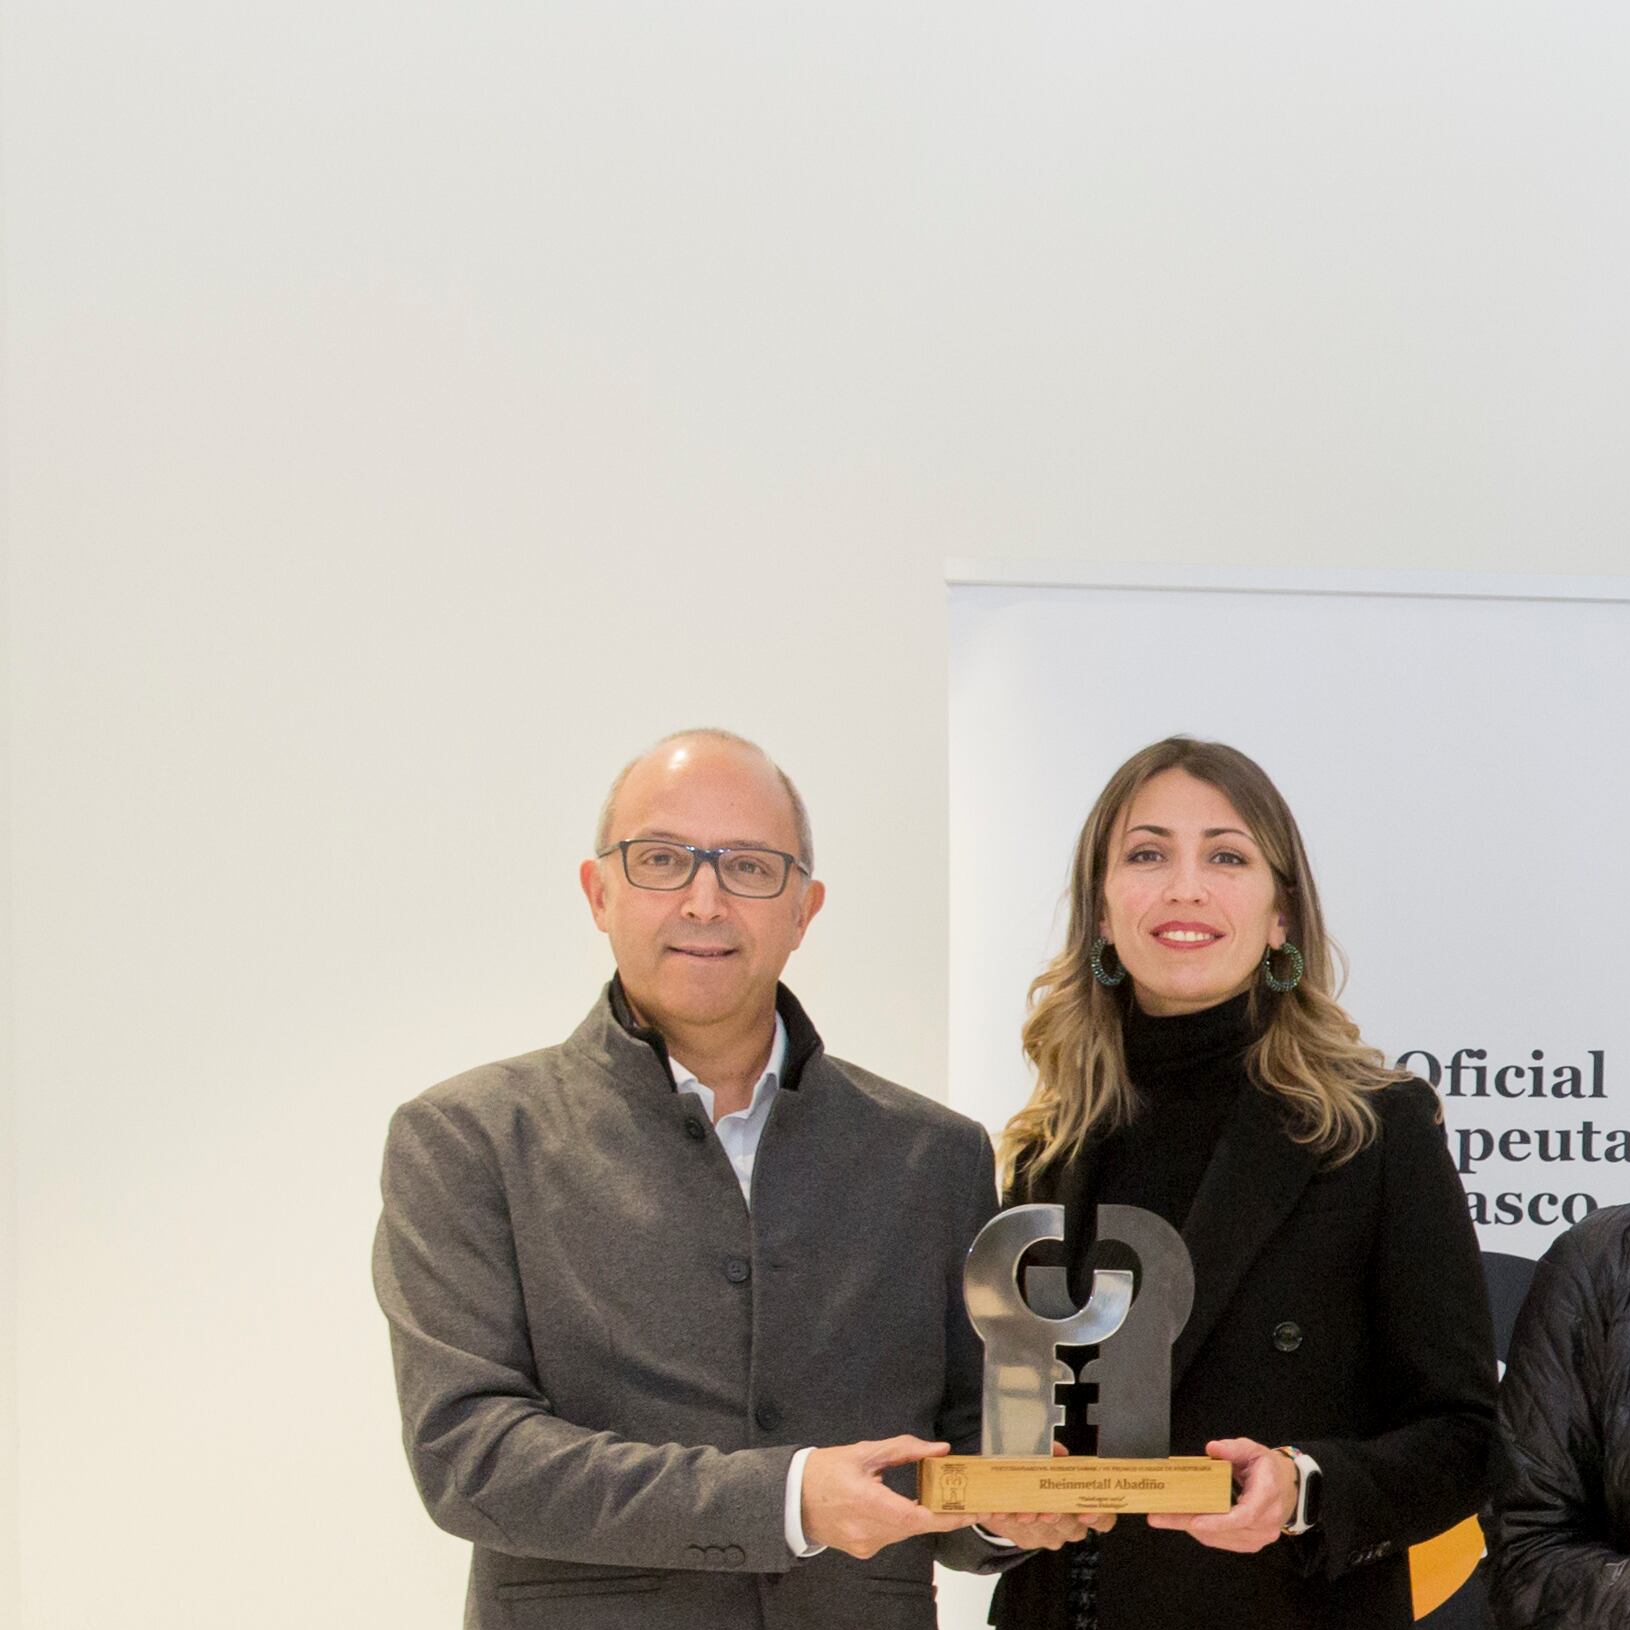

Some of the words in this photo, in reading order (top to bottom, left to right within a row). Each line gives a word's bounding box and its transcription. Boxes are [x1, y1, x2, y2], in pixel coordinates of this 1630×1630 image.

[1466, 1191, 1599, 1226] asco
[1039, 1478, 1111, 1490] Rheinmetall
[1115, 1478, 1165, 1490] Abadiño
